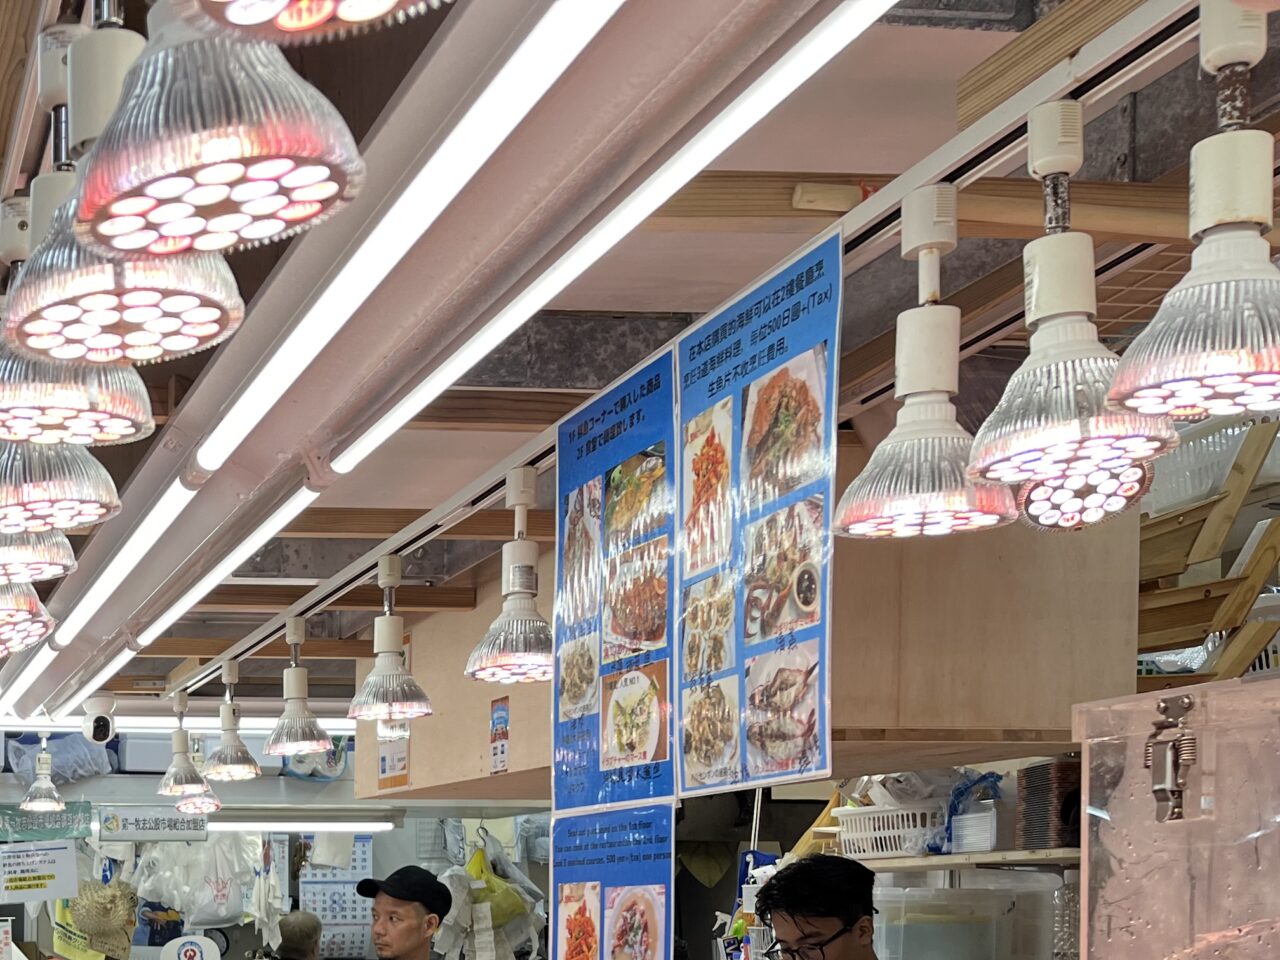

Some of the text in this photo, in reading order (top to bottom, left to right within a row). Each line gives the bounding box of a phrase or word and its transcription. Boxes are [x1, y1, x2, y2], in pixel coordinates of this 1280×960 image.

[121, 817, 206, 832] 第一牧志公設市場組合加盟店
